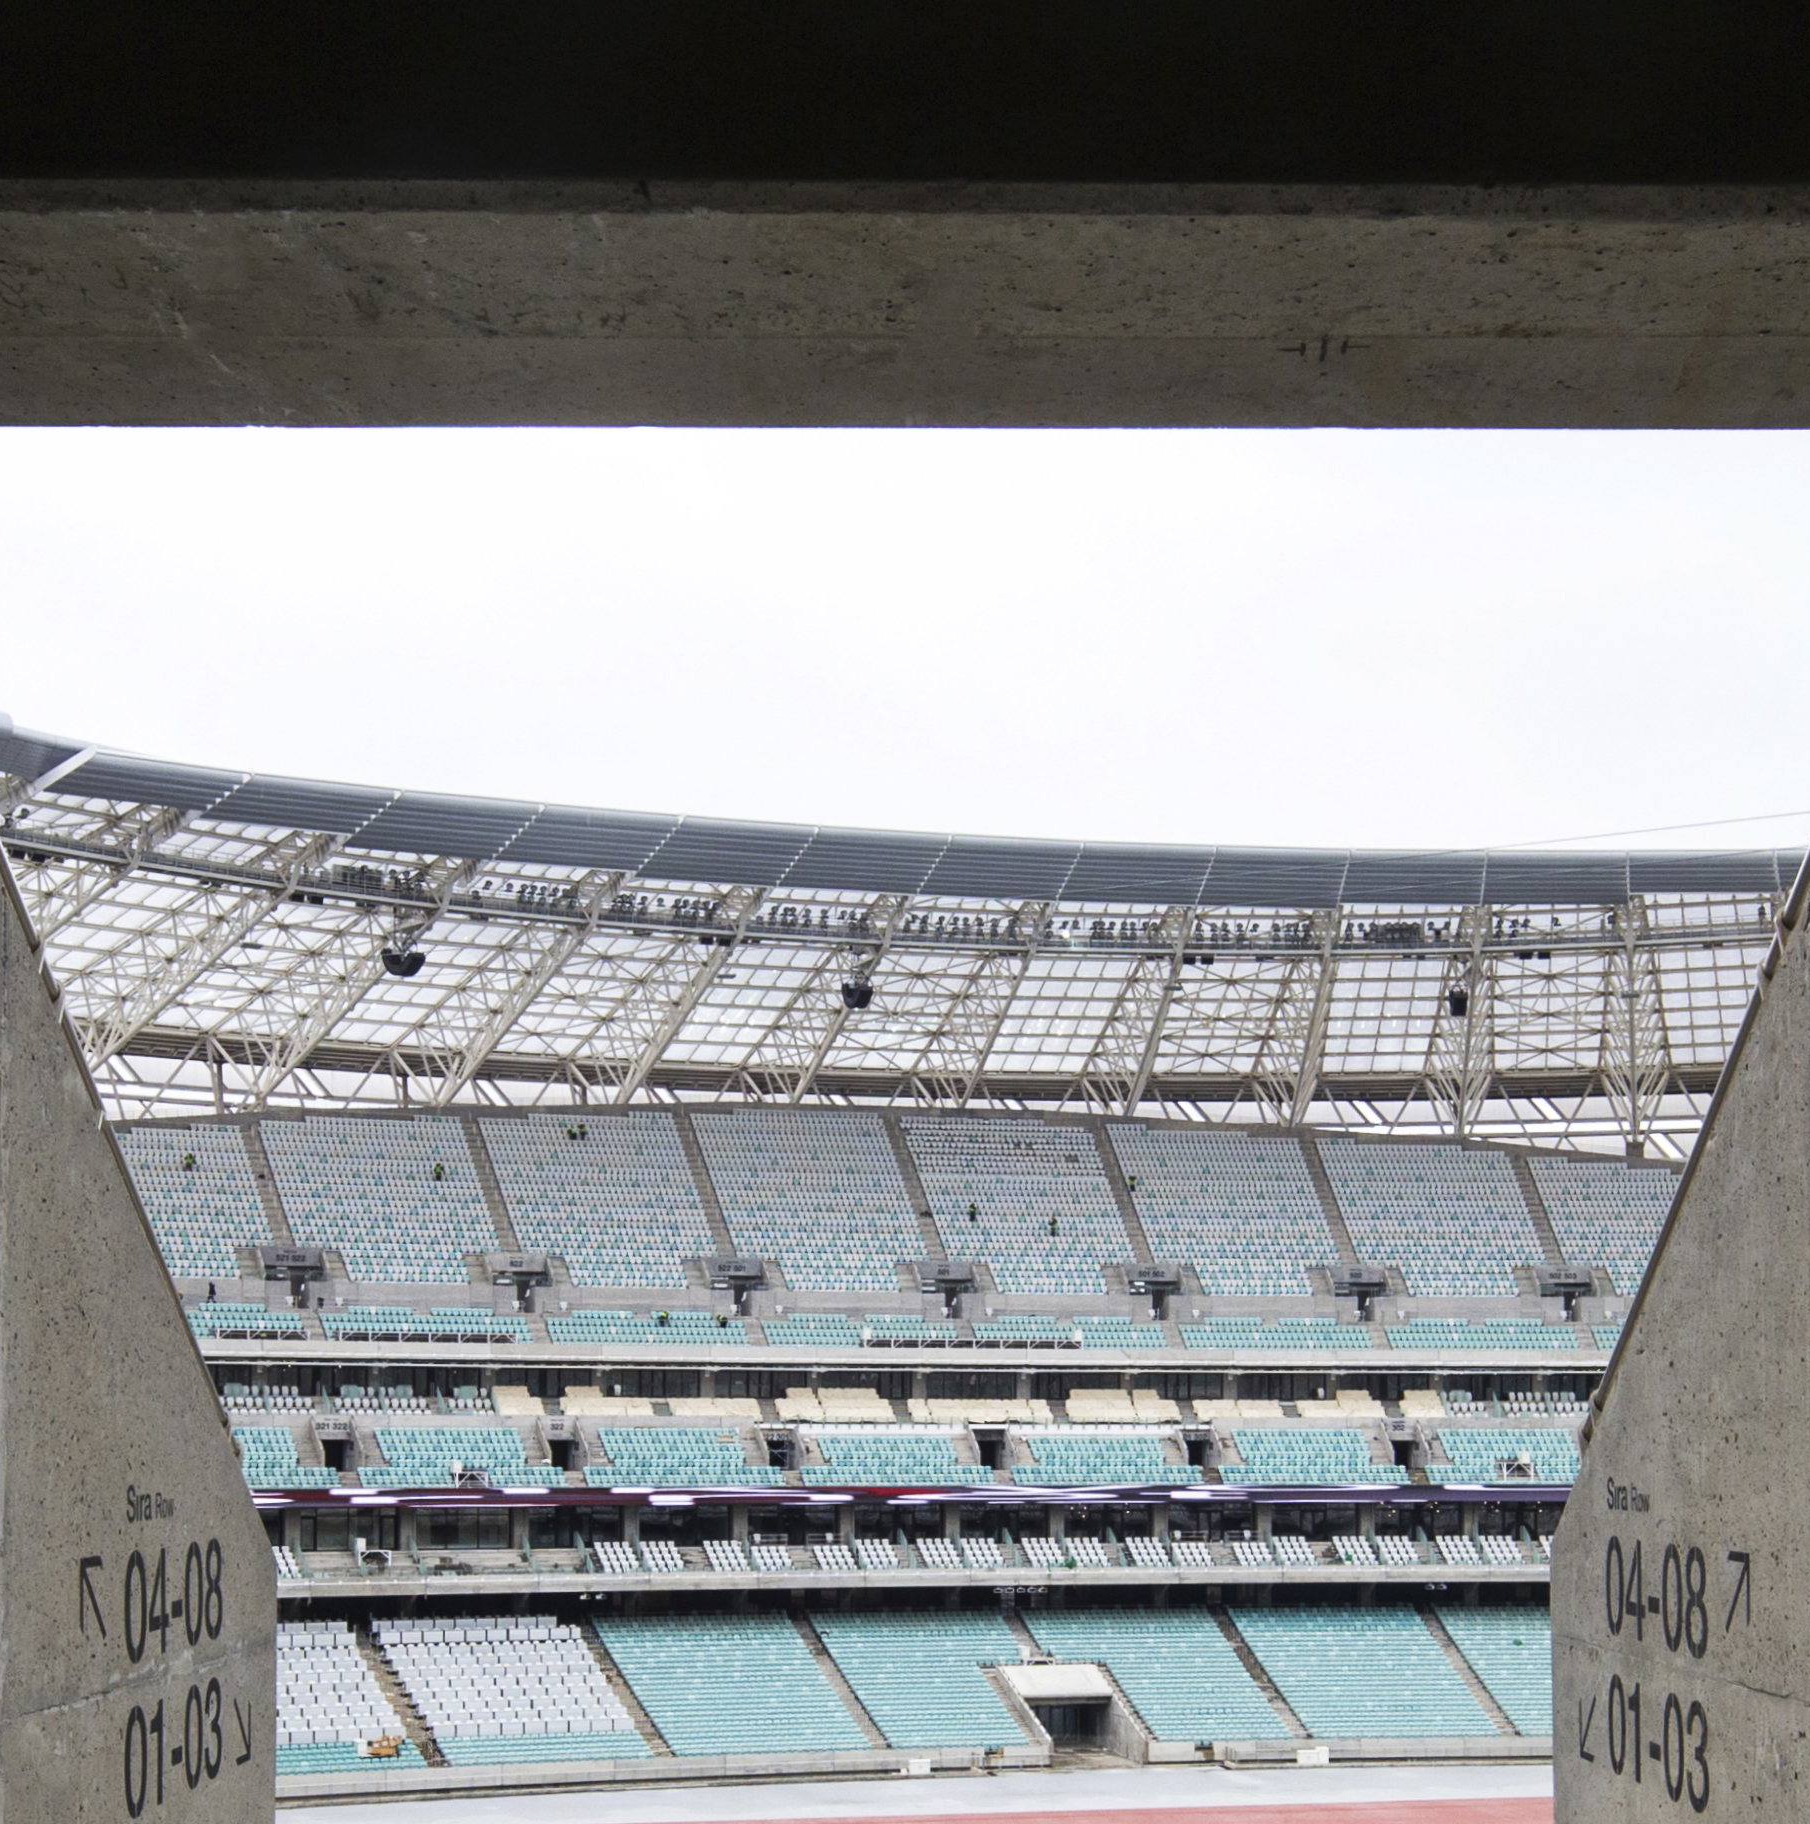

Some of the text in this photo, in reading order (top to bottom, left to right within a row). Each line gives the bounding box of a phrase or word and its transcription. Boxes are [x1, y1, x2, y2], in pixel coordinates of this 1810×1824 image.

[316, 1422, 348, 1431] 321 322
[124, 1538, 223, 1664] 04-08
[1605, 1535, 1708, 1659] 04-08
[124, 1677, 223, 1819] 01-03
[1608, 1674, 1710, 1813] 01-03
